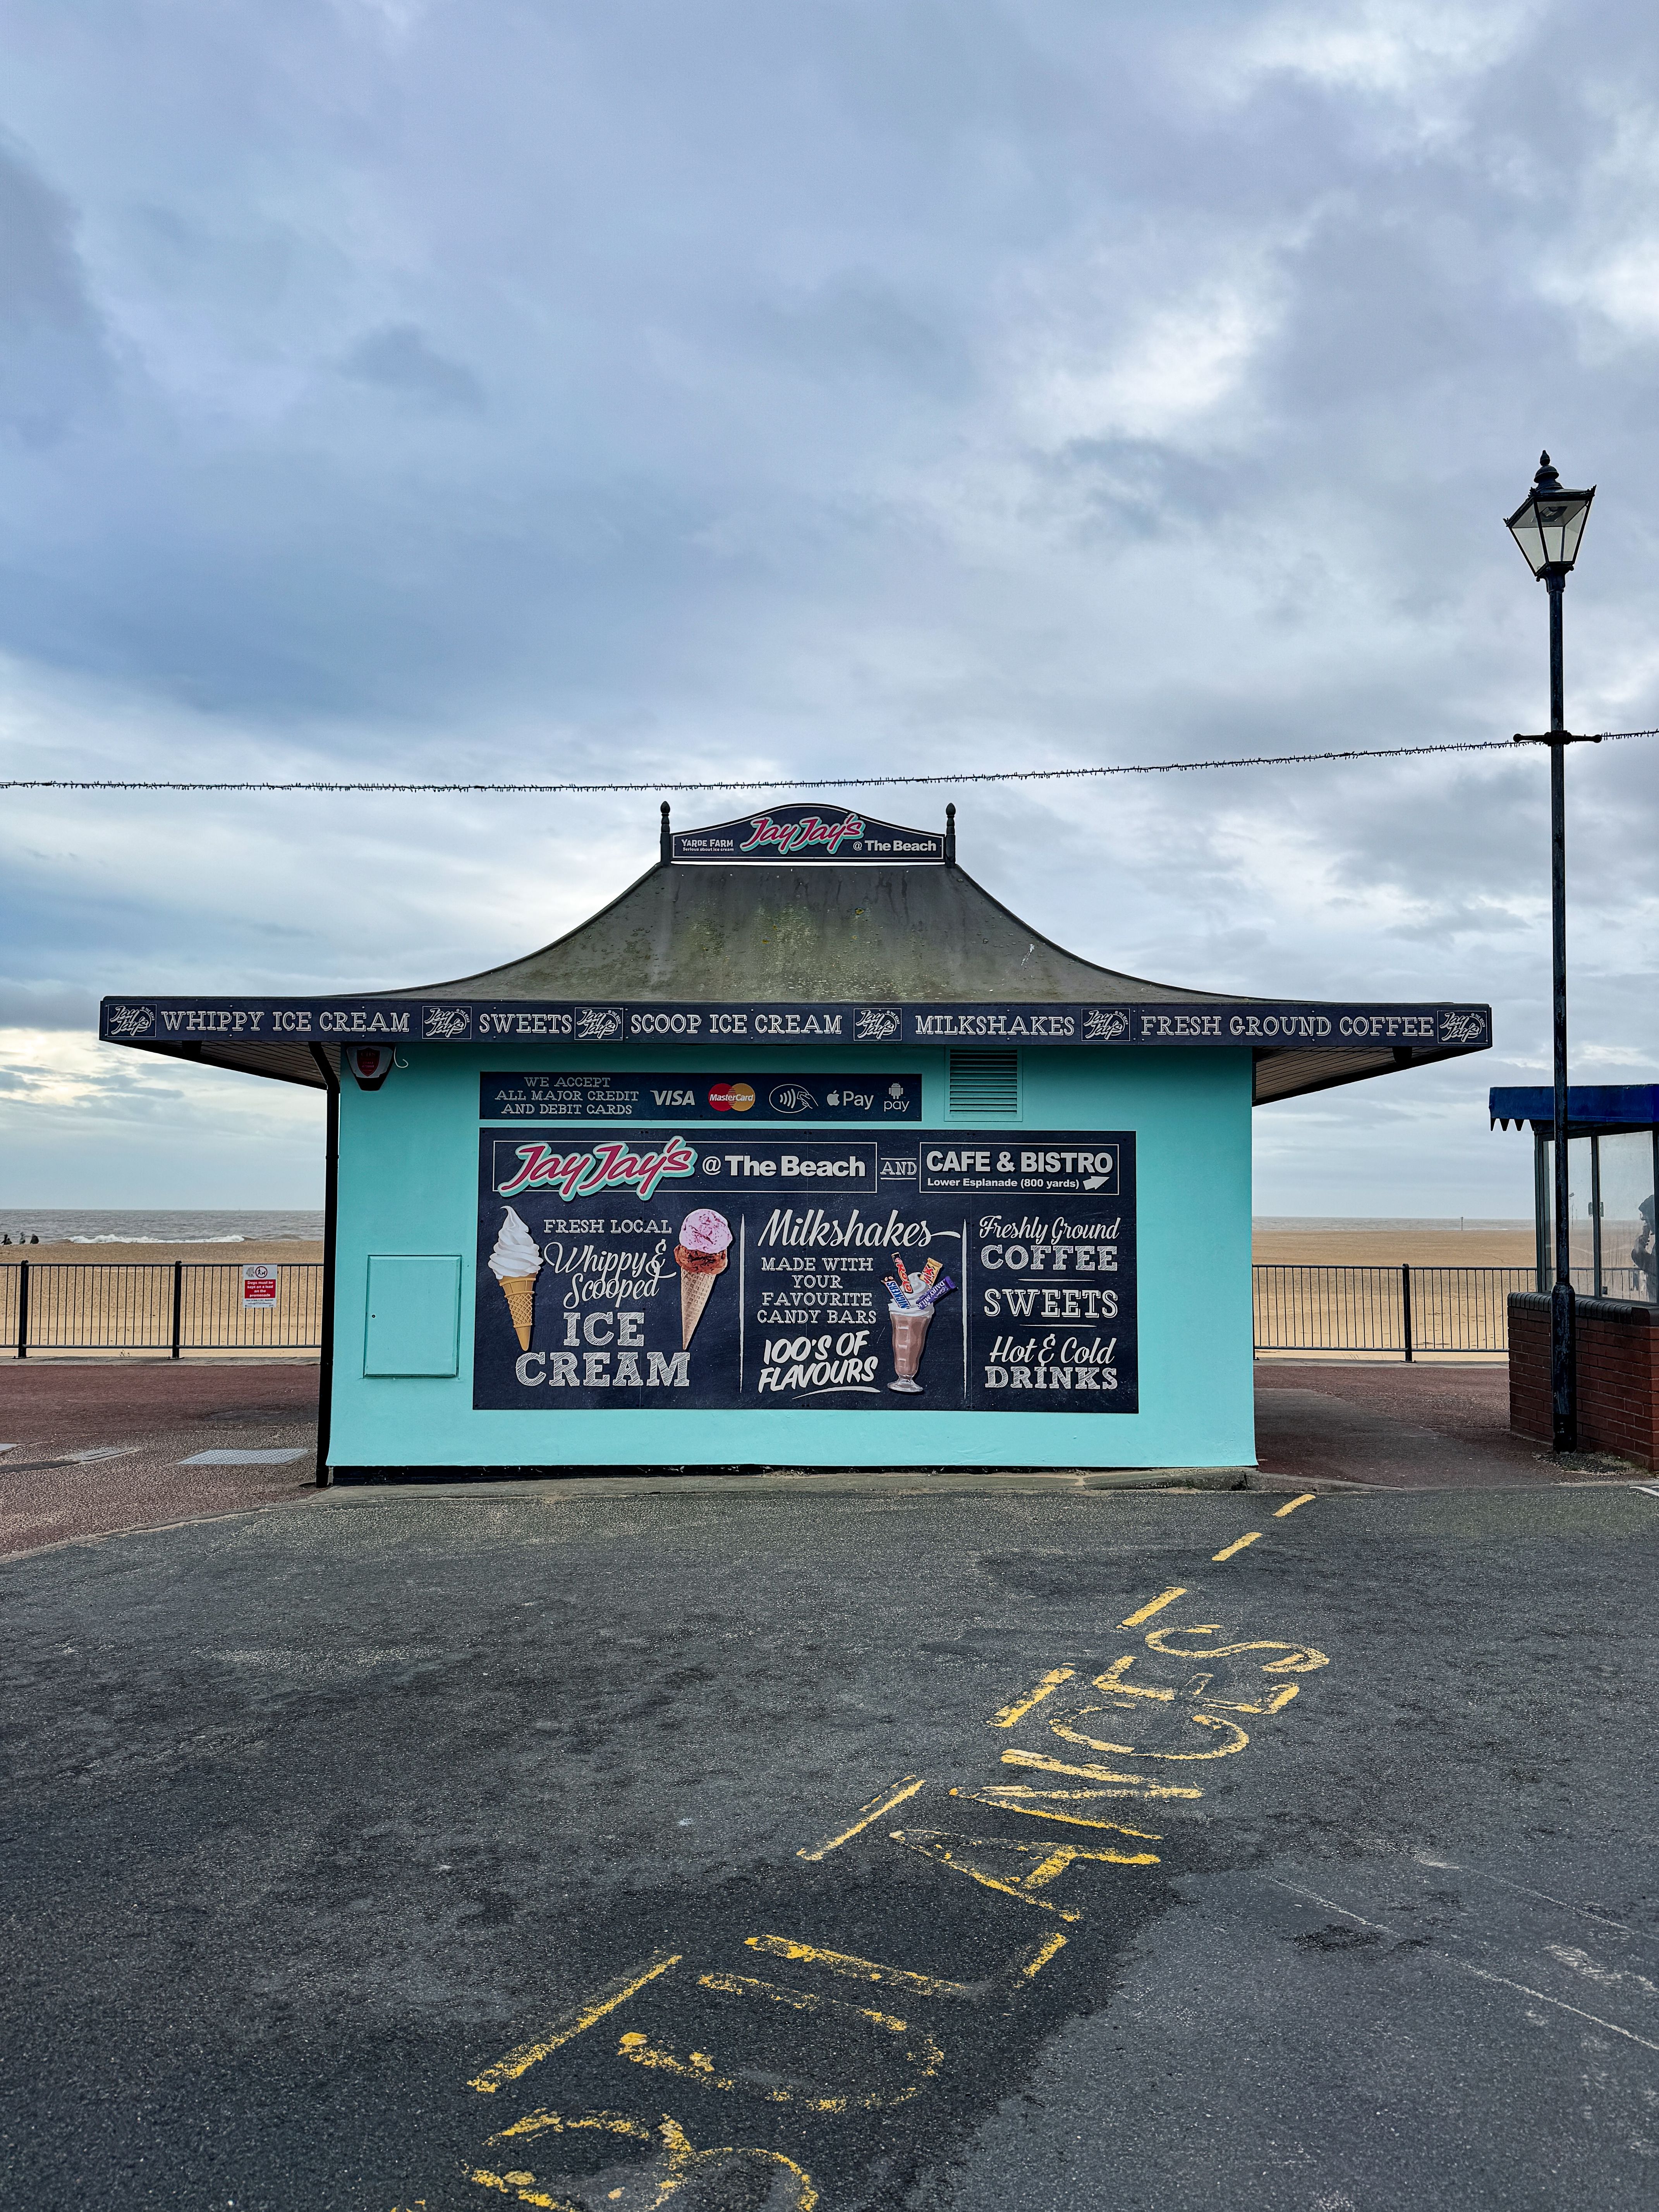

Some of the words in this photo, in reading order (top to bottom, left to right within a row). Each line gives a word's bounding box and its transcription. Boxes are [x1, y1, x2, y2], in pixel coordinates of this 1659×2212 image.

[853, 841, 862, 851] @
[865, 840, 892, 851] The
[893, 840, 936, 852] Beach
[110, 1006, 139, 1023] Jay
[161, 1011, 264, 1031] WHIPPY
[273, 1012, 311, 1031] ICE
[319, 1012, 410, 1032] CREAM
[424, 1008, 454, 1024] Jay
[479, 1013, 572, 1034] SWEETS
[577, 1009, 606, 1025] Jay
[631, 1014, 701, 1034] SCOOP
[709, 1014, 747, 1034] ICE
[755, 1014, 842, 1034] CREAM
[855, 1010, 885, 1026] Jay
[1084, 1010, 1113, 1026] Jay
[1439, 1012, 1470, 1029] Jay
[111, 1017, 149, 1036] Jay's
[426, 1018, 464, 1037] Jay's
[578, 1020, 616, 1039] Jay's
[857, 1020, 895, 1039] Jay's
[915, 1015, 1075, 1036] MILKSHAKES
[1085, 1020, 1123, 1040] Jay's
[1141, 1015, 1221, 1036] FRESH
[1229, 1015, 1332, 1037] GROUND
[1340, 1016, 1434, 1037] COFFEE
[1441, 1023, 1480, 1042] Jay's
[524, 1077, 549, 1087] WE
[554, 1077, 611, 1087] ACCEPT
[495, 1091, 526, 1101] ALL
[532, 1091, 583, 1101] MAJOR
[587, 1091, 639, 1101] CREDIT
[650, 1090, 695, 1105] VISA
[709, 1094, 753, 1102] MasterCard
[843, 1091, 874, 1109] Pay
[501, 1104, 535, 1114] AND
[540, 1104, 582, 1115] DEBIT
[587, 1104, 632, 1115] CARDS
[884, 1100, 909, 1112] pay
[702, 1156, 721, 1175] @
[725, 1155, 776, 1176] The
[781, 1156, 865, 1176] Beach
[880, 1161, 917, 1176] AND
[927, 1151, 991, 1172] CAFE
[996, 1151, 1015, 1172] &
[1021, 1152, 1113, 1173] BISTRO
[927, 1178, 961, 1187] Lower
[963, 1178, 1017, 1188] Esplanade
[1020, 1178, 1044, 1189] (800
[1046, 1179, 1079, 1189] yards)
[544, 1219, 605, 1234] FRESH
[610, 1219, 672, 1234] LOCAL
[757, 1209, 961, 1247] Milkshakes
[979, 1215, 1048, 1245] Freshly
[1051, 1217, 1121, 1245] Ground
[543, 1242, 648, 1282] Whippy
[646, 1238, 677, 1279] &
[761, 1257, 816, 1272] MADE
[822, 1257, 874, 1272] WITH
[981, 1245, 1117, 1271] COFFEE
[563, 1273, 660, 1309] Scooped
[792, 1275, 843, 1289] YOUR
[930, 1279, 945, 1298] DAIRY
[762, 1292, 872, 1307] FAVOURITE
[886, 1281, 911, 1309] NICKERS
[984, 1288, 1118, 1318] SWEETS
[757, 1310, 820, 1324] CANDY
[827, 1310, 877, 1324] BARS
[563, 1311, 644, 1346] ICE
[764, 1334, 832, 1365] 100'S
[836, 1330, 870, 1357] OF
[989, 1336, 1037, 1363] Hot
[1038, 1333, 1056, 1367] &
[1061, 1337, 1117, 1364] Cold
[515, 1352, 690, 1387] CREAM
[758, 1356, 878, 1393] FLAVOURS
[985, 1366, 1117, 1389] DRINKS
